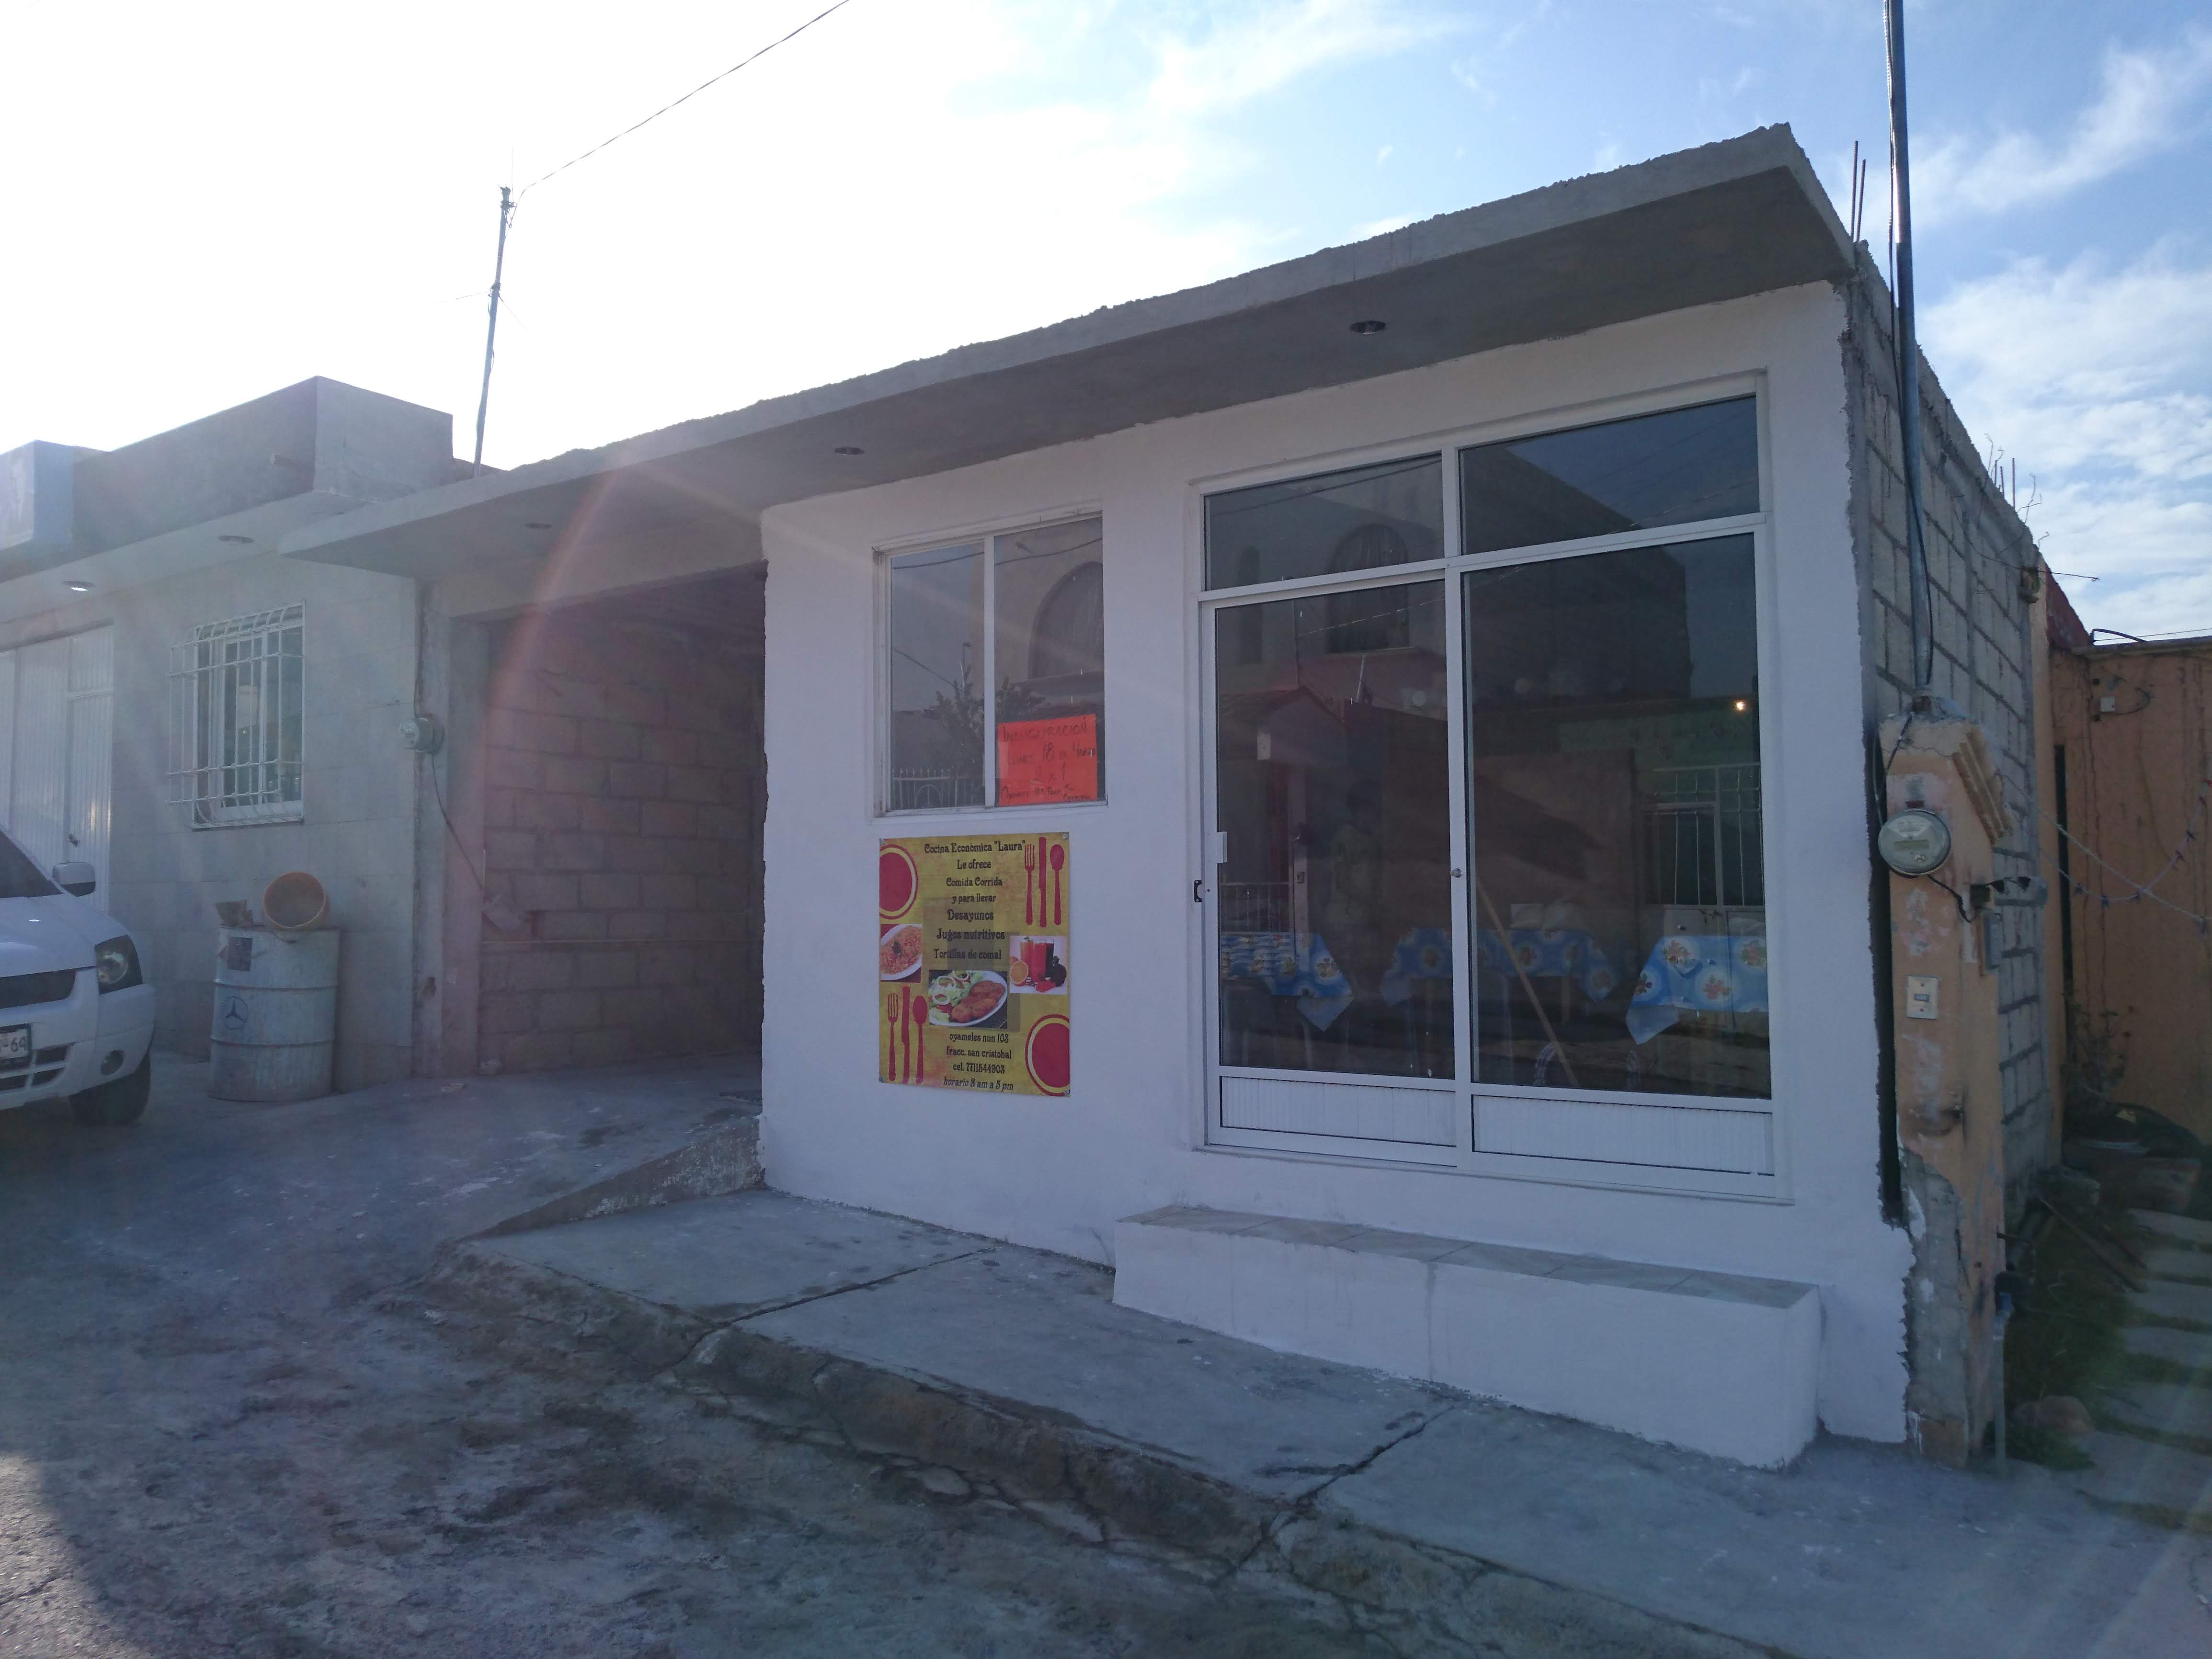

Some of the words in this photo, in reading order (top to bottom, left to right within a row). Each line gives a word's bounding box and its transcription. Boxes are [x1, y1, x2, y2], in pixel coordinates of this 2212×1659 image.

[1043, 742, 1054, 761] 18
[924, 843, 949, 853] Cocina
[994, 840, 1026, 851] "Laura"
[957, 859, 967, 869] Le
[968, 859, 992, 869] ofrece
[946, 877, 973, 886] Comida
[975, 876, 1003, 886] Corrida
[952, 896, 957, 904] y
[958, 895, 974, 904] para
[976, 893, 996, 902] llevar
[947, 909, 994, 922] Desayunos
[936, 928, 961, 942] Jugos
[963, 929, 1005, 940] nutritivos
[934, 948, 966, 959] Tortillas
[968, 949, 977, 959] de
[979, 949, 1002, 959] comal
[997, 1034, 1009, 1043] 103
[946, 1045, 966, 1056] fracc.
[981, 1049, 1012, 1059] cristobal
[953, 1062, 964, 1071] cel.
[943, 1076, 969, 1087] horario
[970, 1078, 975, 1087] 8
[996, 1080, 1001, 1089] 5
[1002, 1083, 1014, 1091] pm
